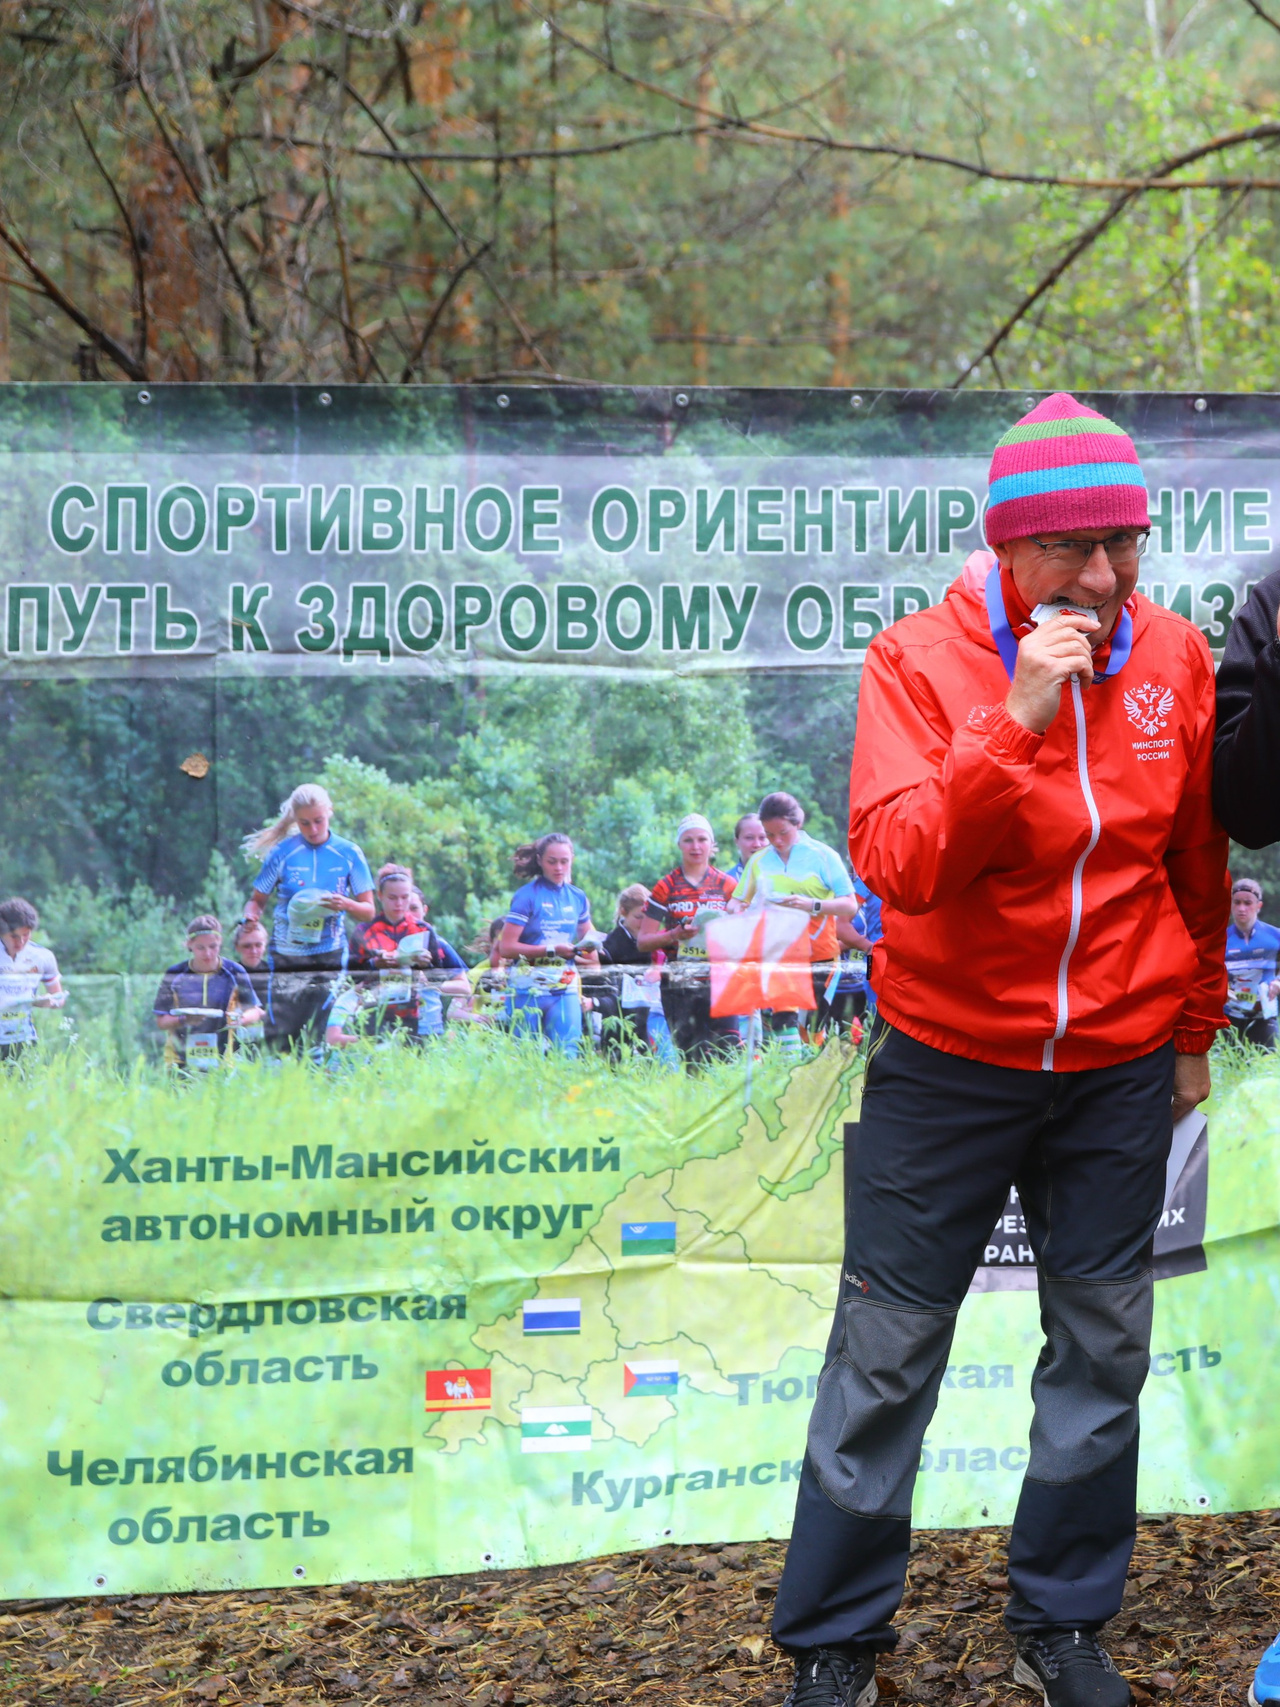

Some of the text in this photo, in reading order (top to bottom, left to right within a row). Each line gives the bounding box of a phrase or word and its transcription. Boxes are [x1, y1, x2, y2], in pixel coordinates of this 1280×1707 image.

[51, 484, 561, 555] СПОРТИВНОЕ
[591, 485, 1275, 555] ОРИЕНТИРНИЕ
[6, 584, 200, 654] ПУТЬ
[230, 584, 272, 654] К
[296, 583, 760, 664] ЗДОРОВОМУ
[784, 582, 951, 652] ОБР
[1131, 738, 1175, 750] МИНСПОРТ
[1136, 751, 1170, 761] РОССИИ
[102, 1137, 622, 1184] Ханты-Мансийский
[101, 1198, 594, 1242] автономный округ
[86, 1293, 467, 1337] Свердловская
[161, 1350, 379, 1387] область
[46, 1445, 414, 1486] Челябинская
[572, 1459, 804, 1512] Курганск
[107, 1509, 331, 1546] область
